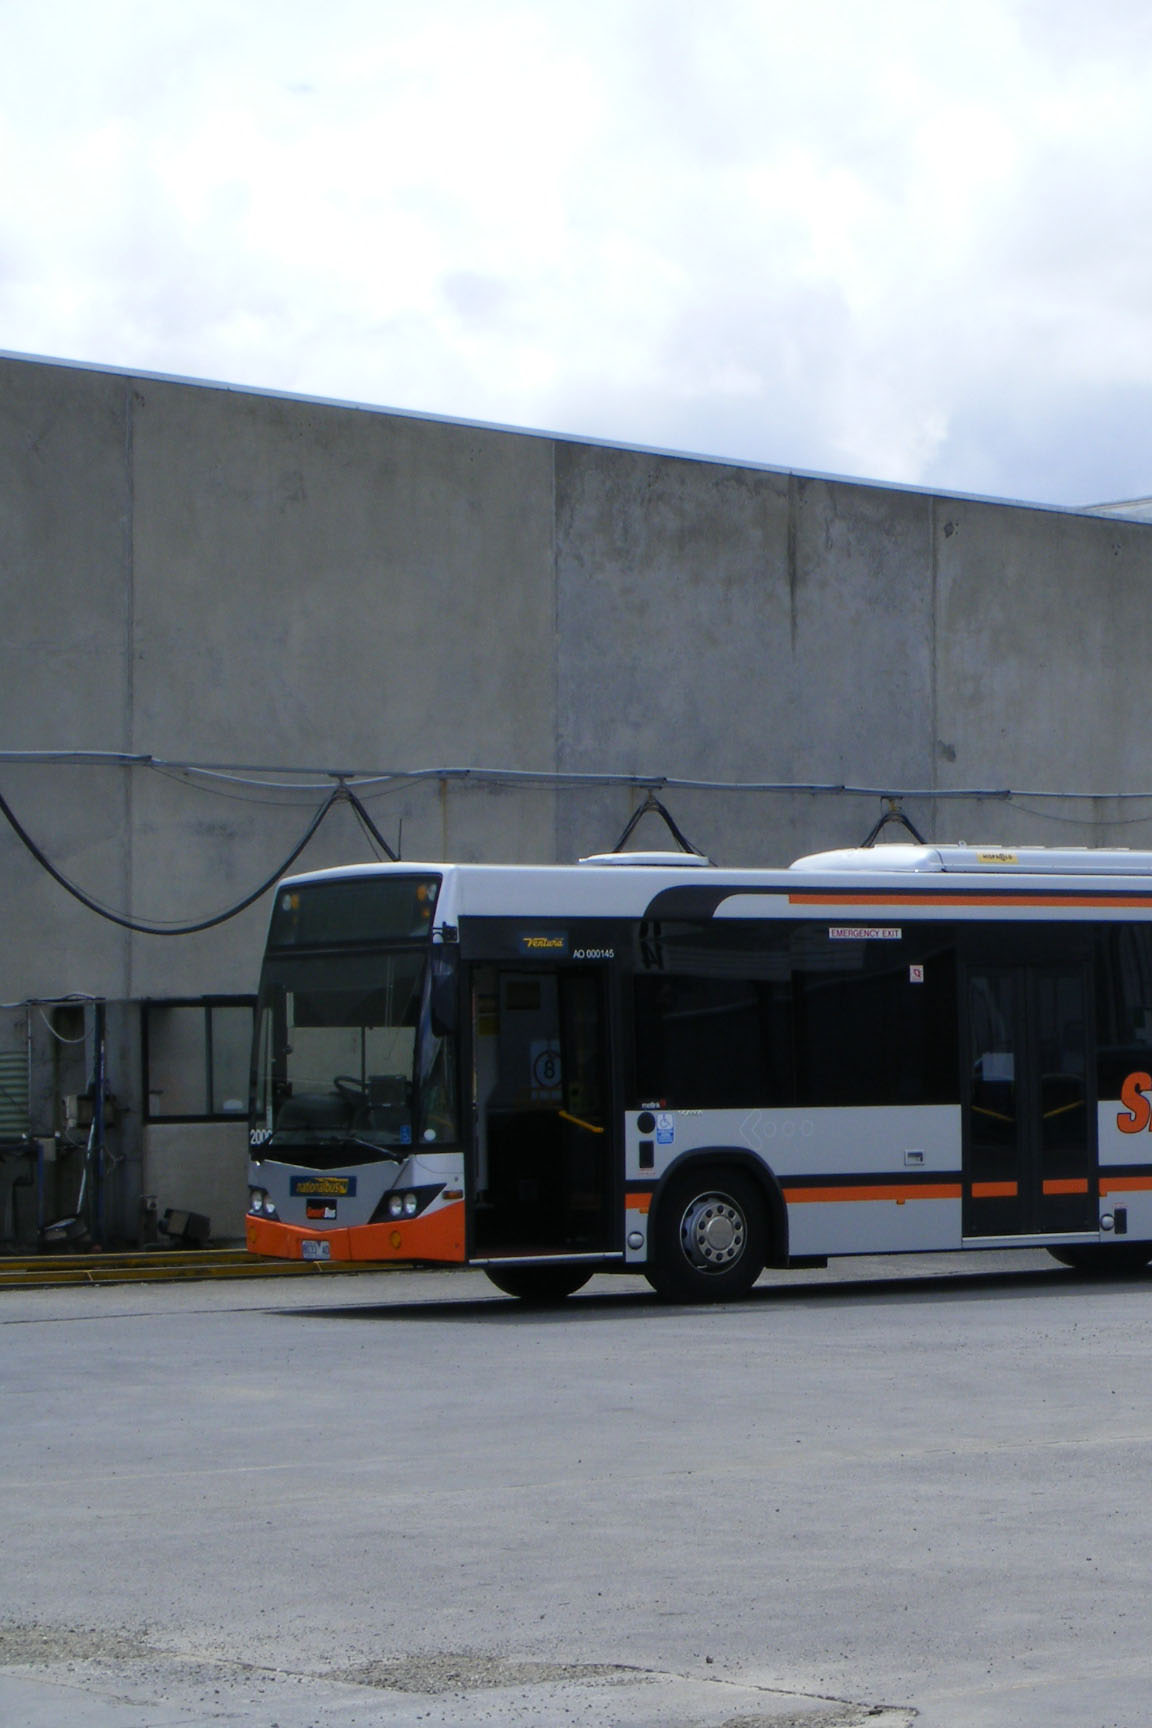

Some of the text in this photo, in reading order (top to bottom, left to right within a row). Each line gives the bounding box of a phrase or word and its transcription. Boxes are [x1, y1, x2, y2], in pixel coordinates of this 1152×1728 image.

[831, 929, 899, 937] EMERGENCY EXIT
[586, 949, 614, 958] 000145
